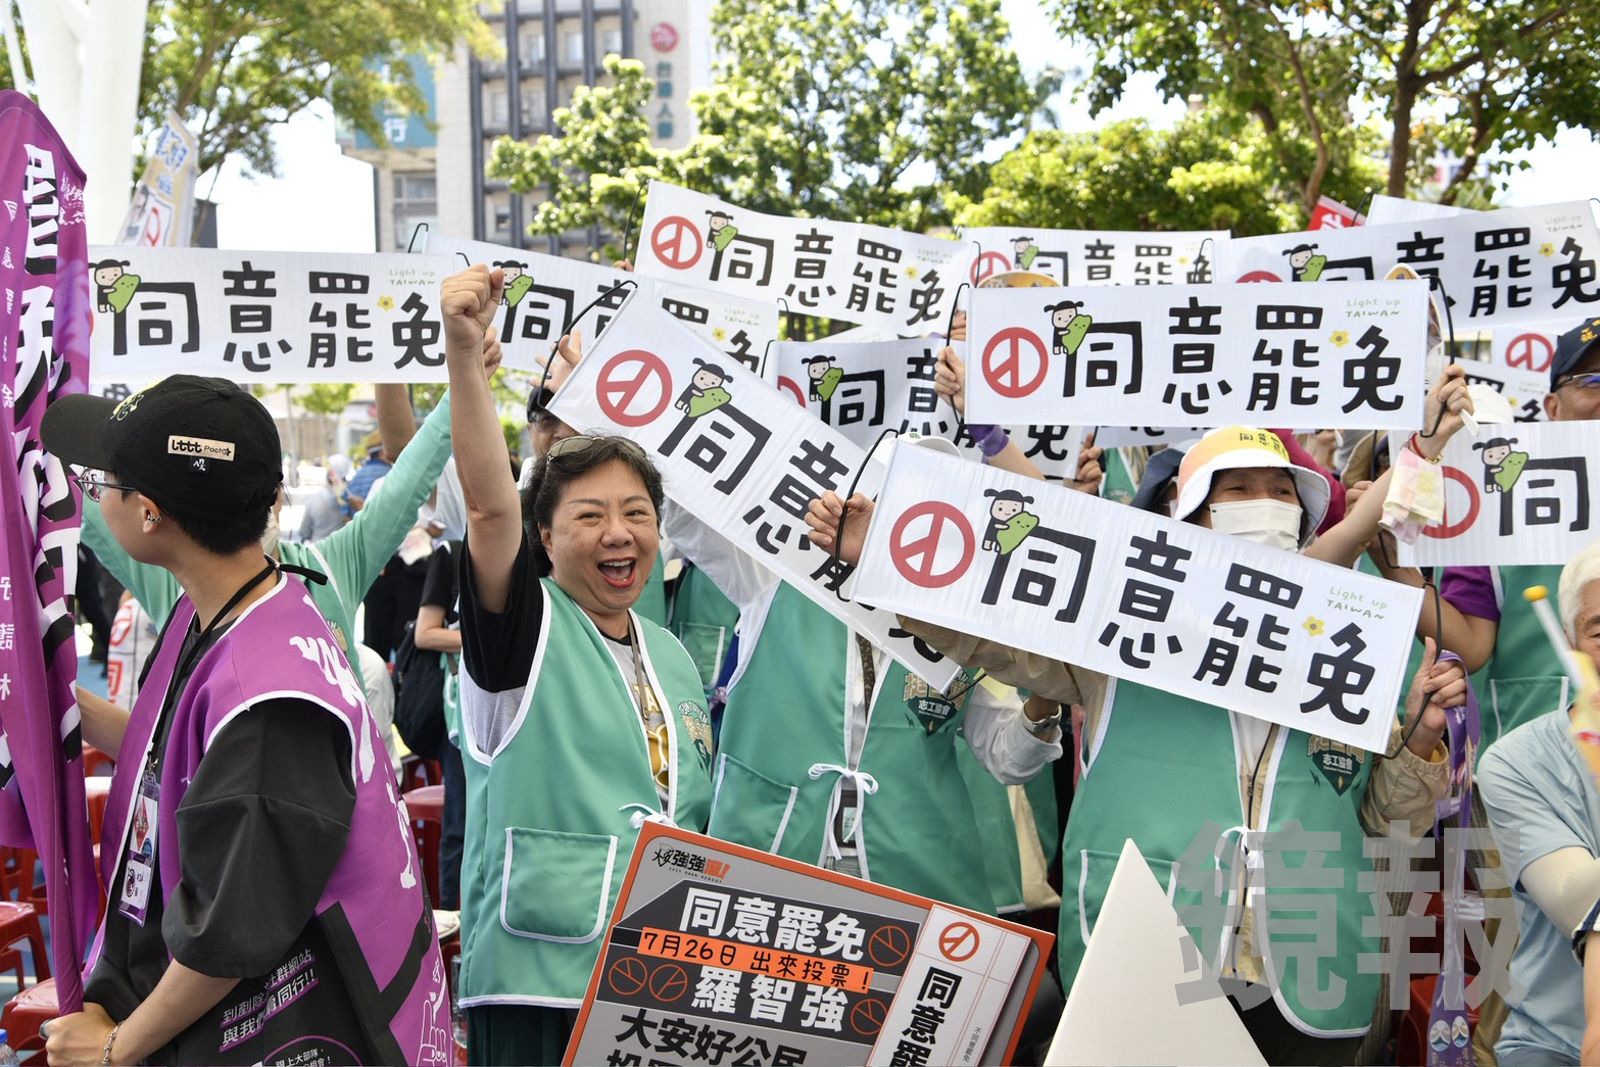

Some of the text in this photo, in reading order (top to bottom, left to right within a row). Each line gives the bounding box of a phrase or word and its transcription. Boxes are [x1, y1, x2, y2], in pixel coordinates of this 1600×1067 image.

[113, 260, 446, 372] 同意罷免
[708, 227, 945, 327] 同意罷免
[1346, 298, 1401, 308] Light up
[1062, 296, 1404, 415] 同意罷免
[1499, 456, 1590, 537] 同
[980, 525, 1376, 725] 同意罷免
[1329, 586, 1388, 610] Light up
[643, 931, 737, 967] 7月26日
[678, 887, 867, 962] 同意罷免
[691, 965, 850, 1033] 羅智強
[889, 966, 963, 1067] 同意罷
